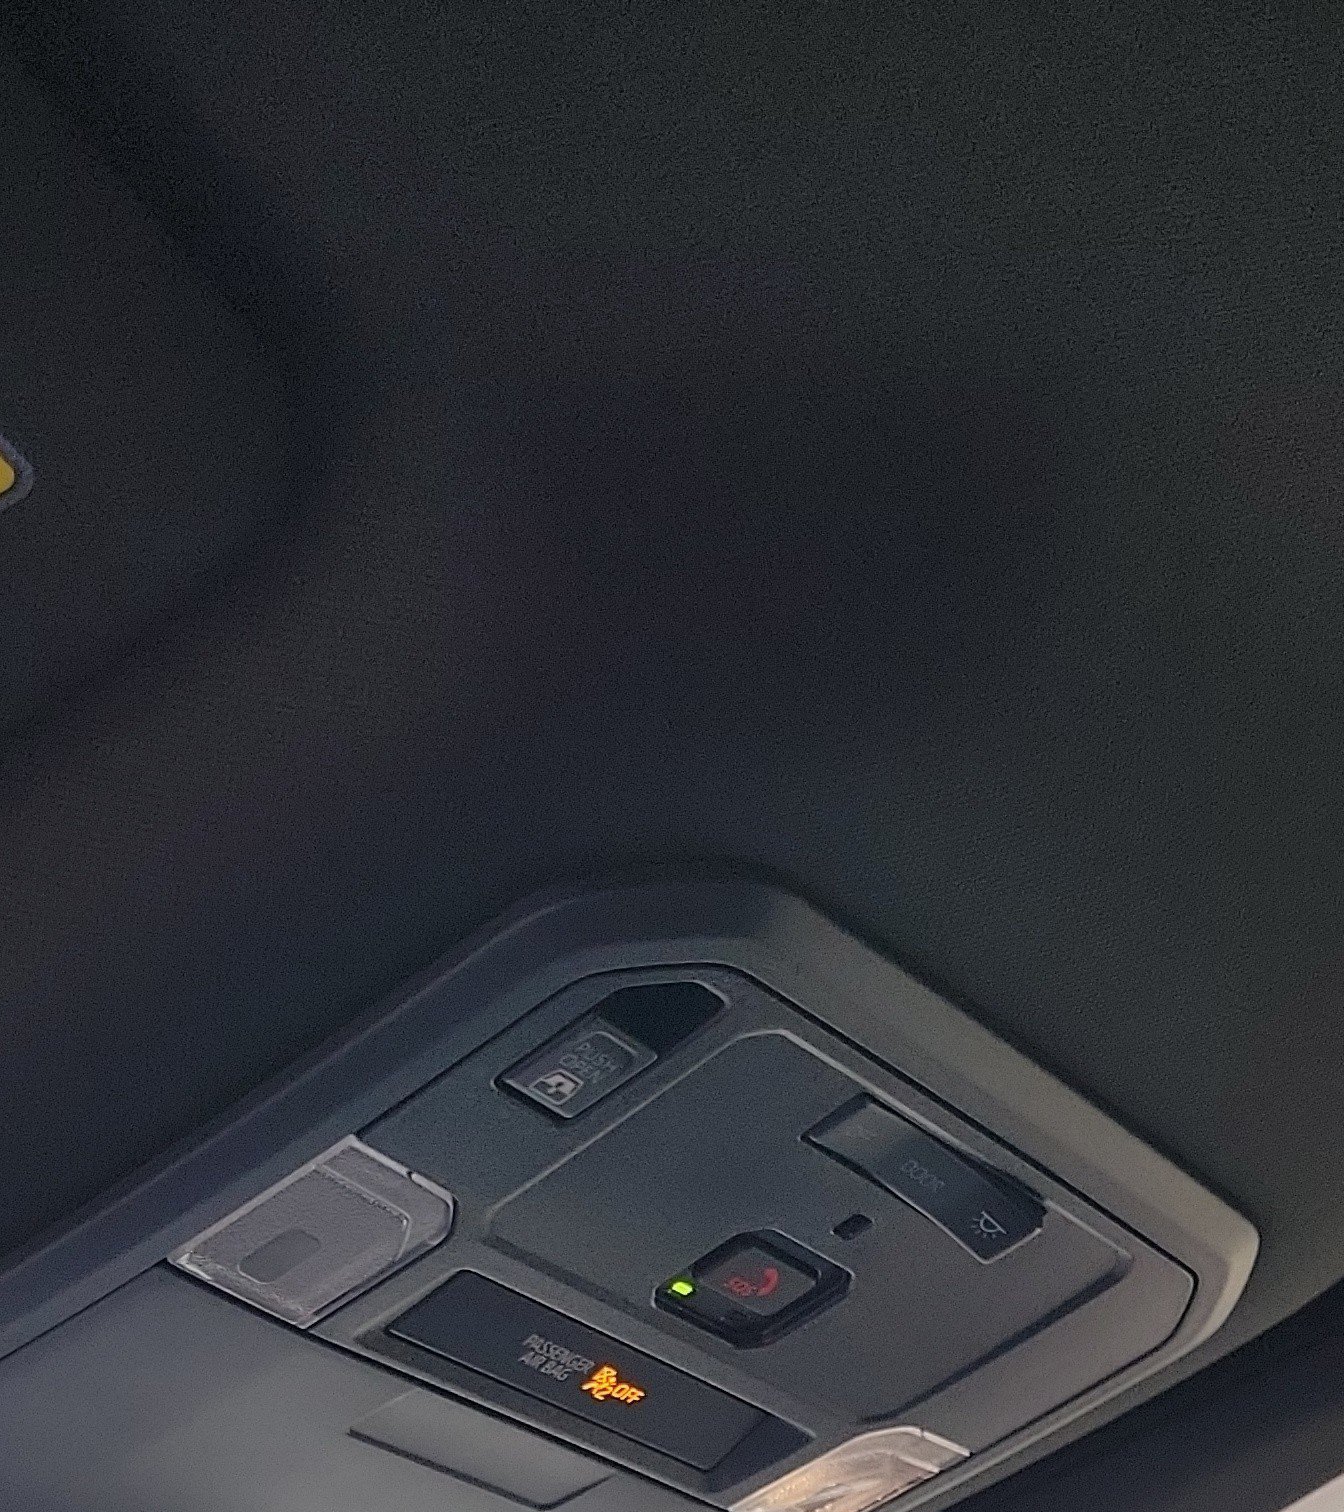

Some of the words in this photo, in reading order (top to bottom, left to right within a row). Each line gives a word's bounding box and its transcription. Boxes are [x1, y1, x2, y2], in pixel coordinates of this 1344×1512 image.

[517, 1351, 547, 1371] AIR
[541, 1360, 573, 1382] BAG
[522, 1333, 595, 1375] PASSENGER
[611, 1383, 646, 1404] OFF
